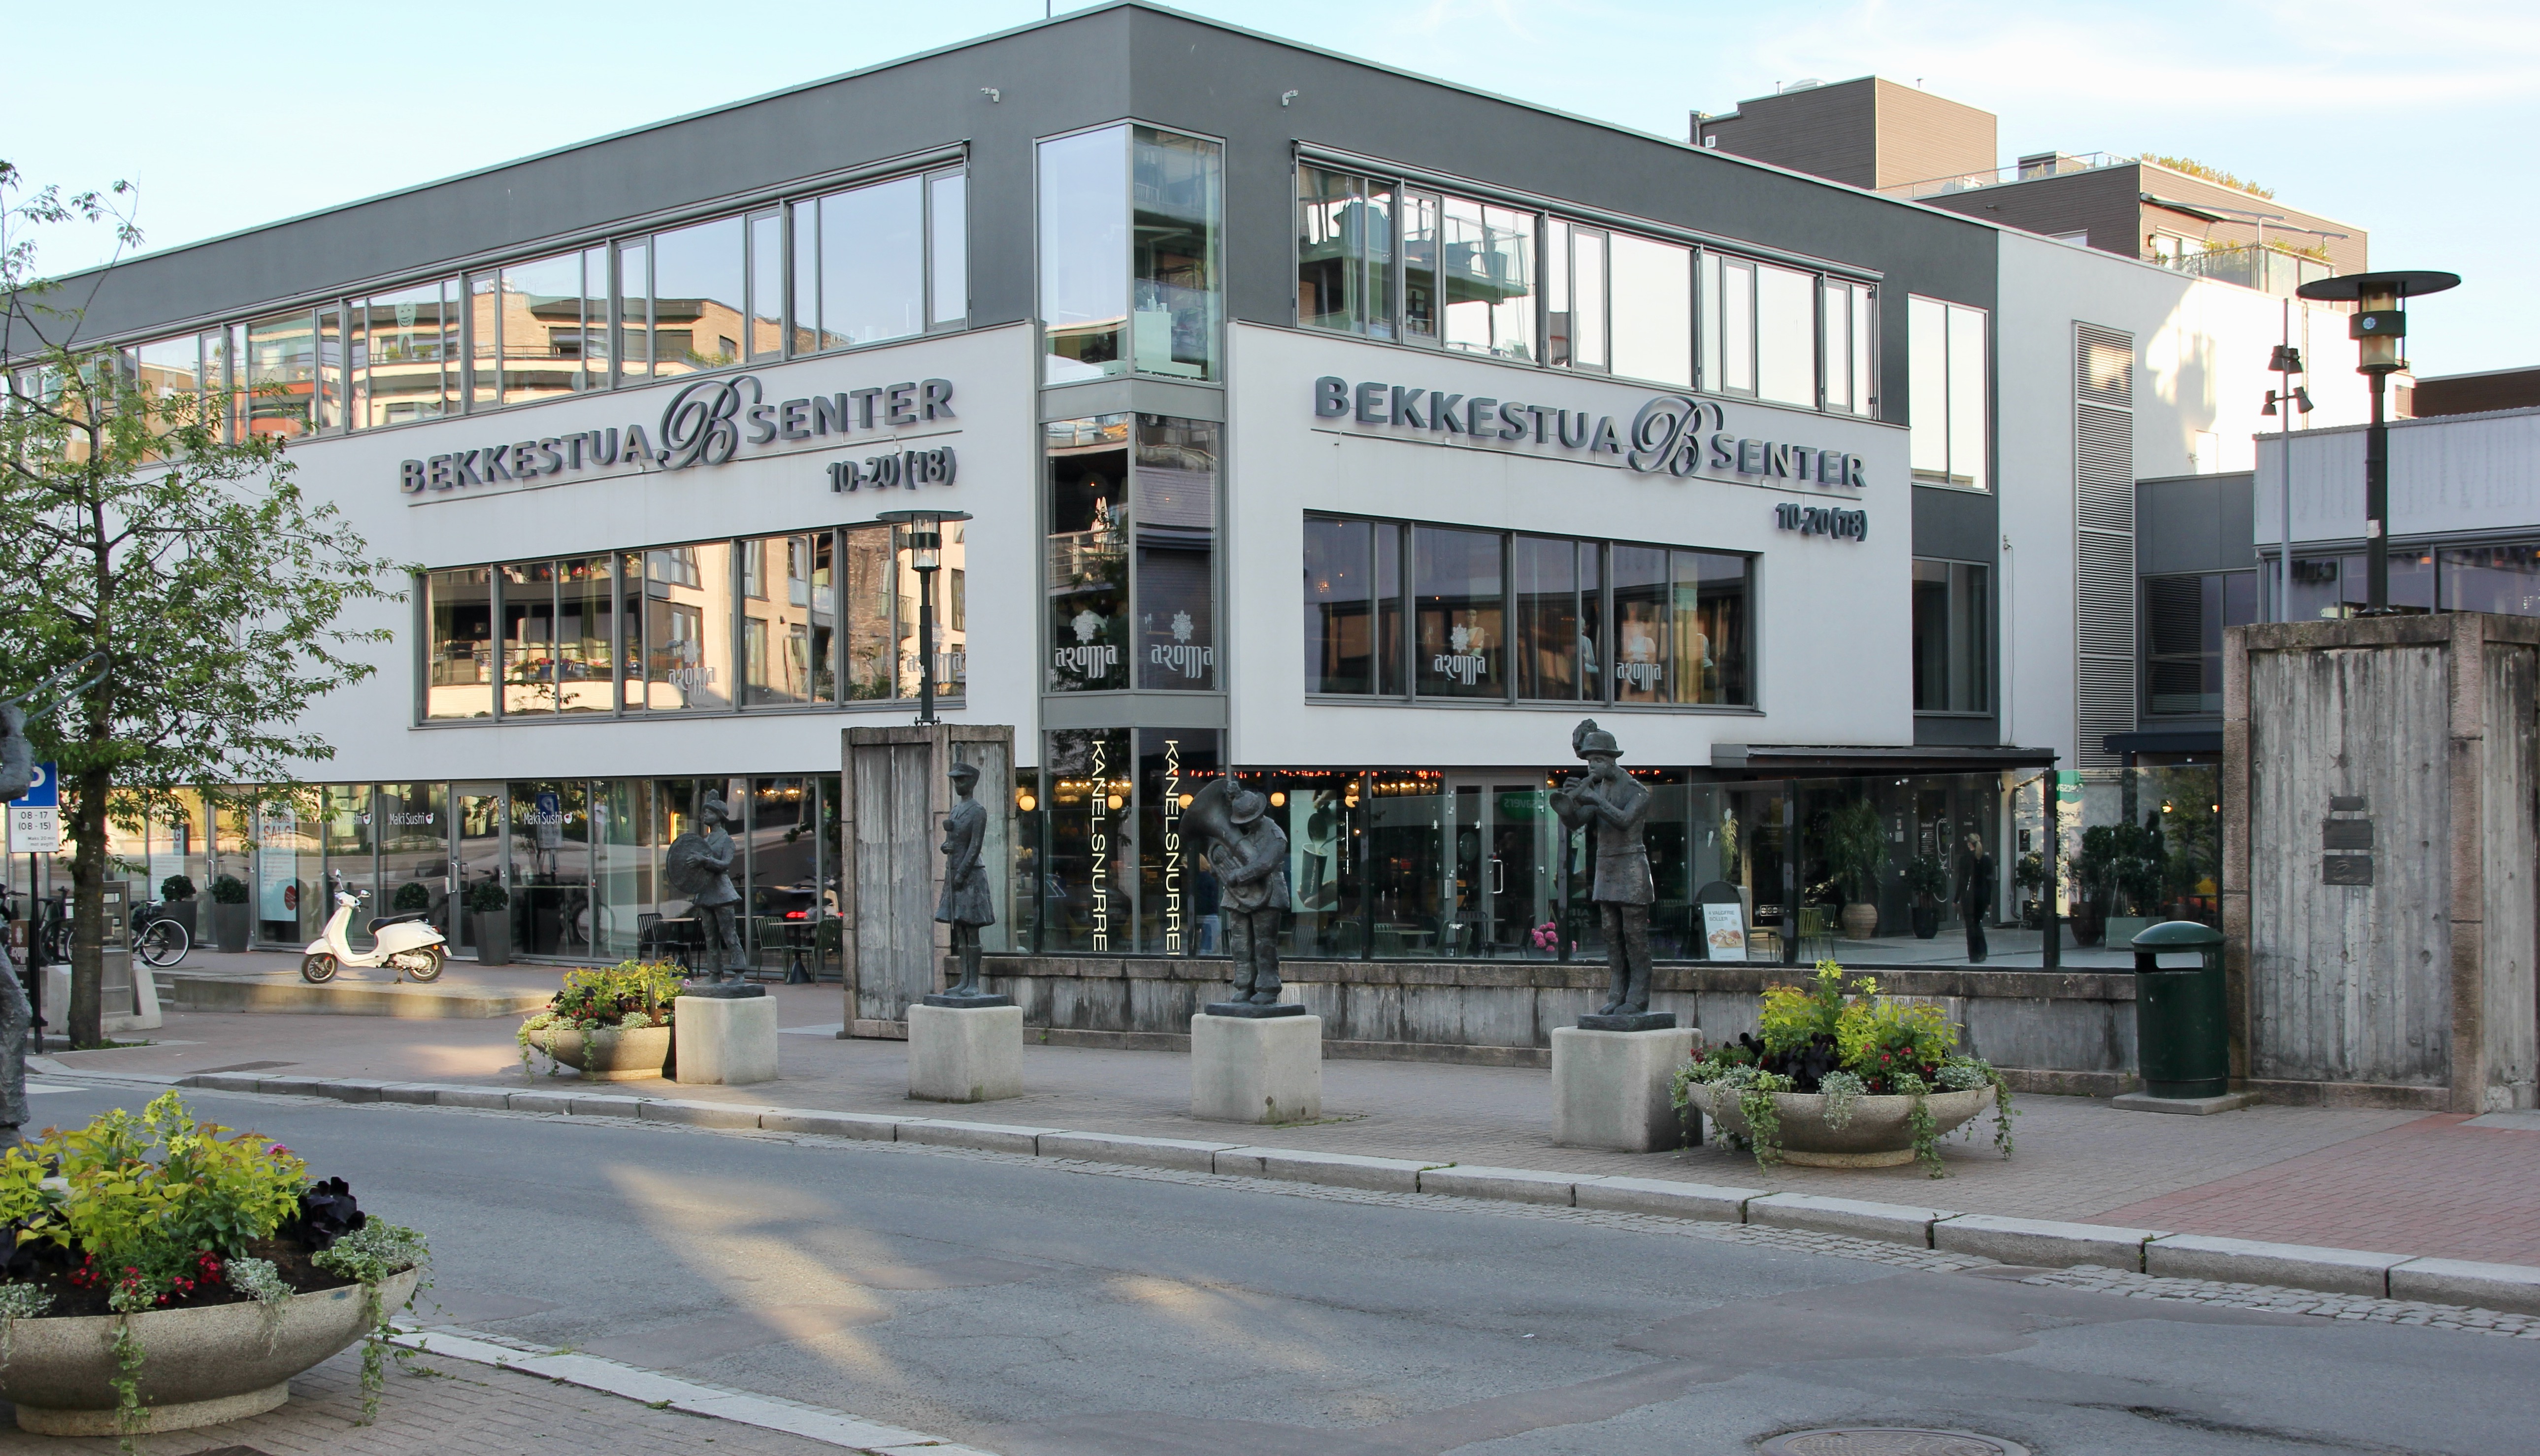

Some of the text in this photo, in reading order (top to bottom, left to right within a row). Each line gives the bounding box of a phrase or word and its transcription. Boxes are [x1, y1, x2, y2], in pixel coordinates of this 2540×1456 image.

[400, 425, 653, 493] BEKKESTUA
[747, 378, 956, 443] SENTER
[1316, 376, 1624, 454] BEKKESTUA
[1711, 433, 1866, 487] SENTER
[19, 822, 33, 830] (08
[390, 812, 425, 825] Maki Sushi
[524, 811, 562, 825] Maki Sushi
[1165, 740, 1180, 955] KANELSNURRE
